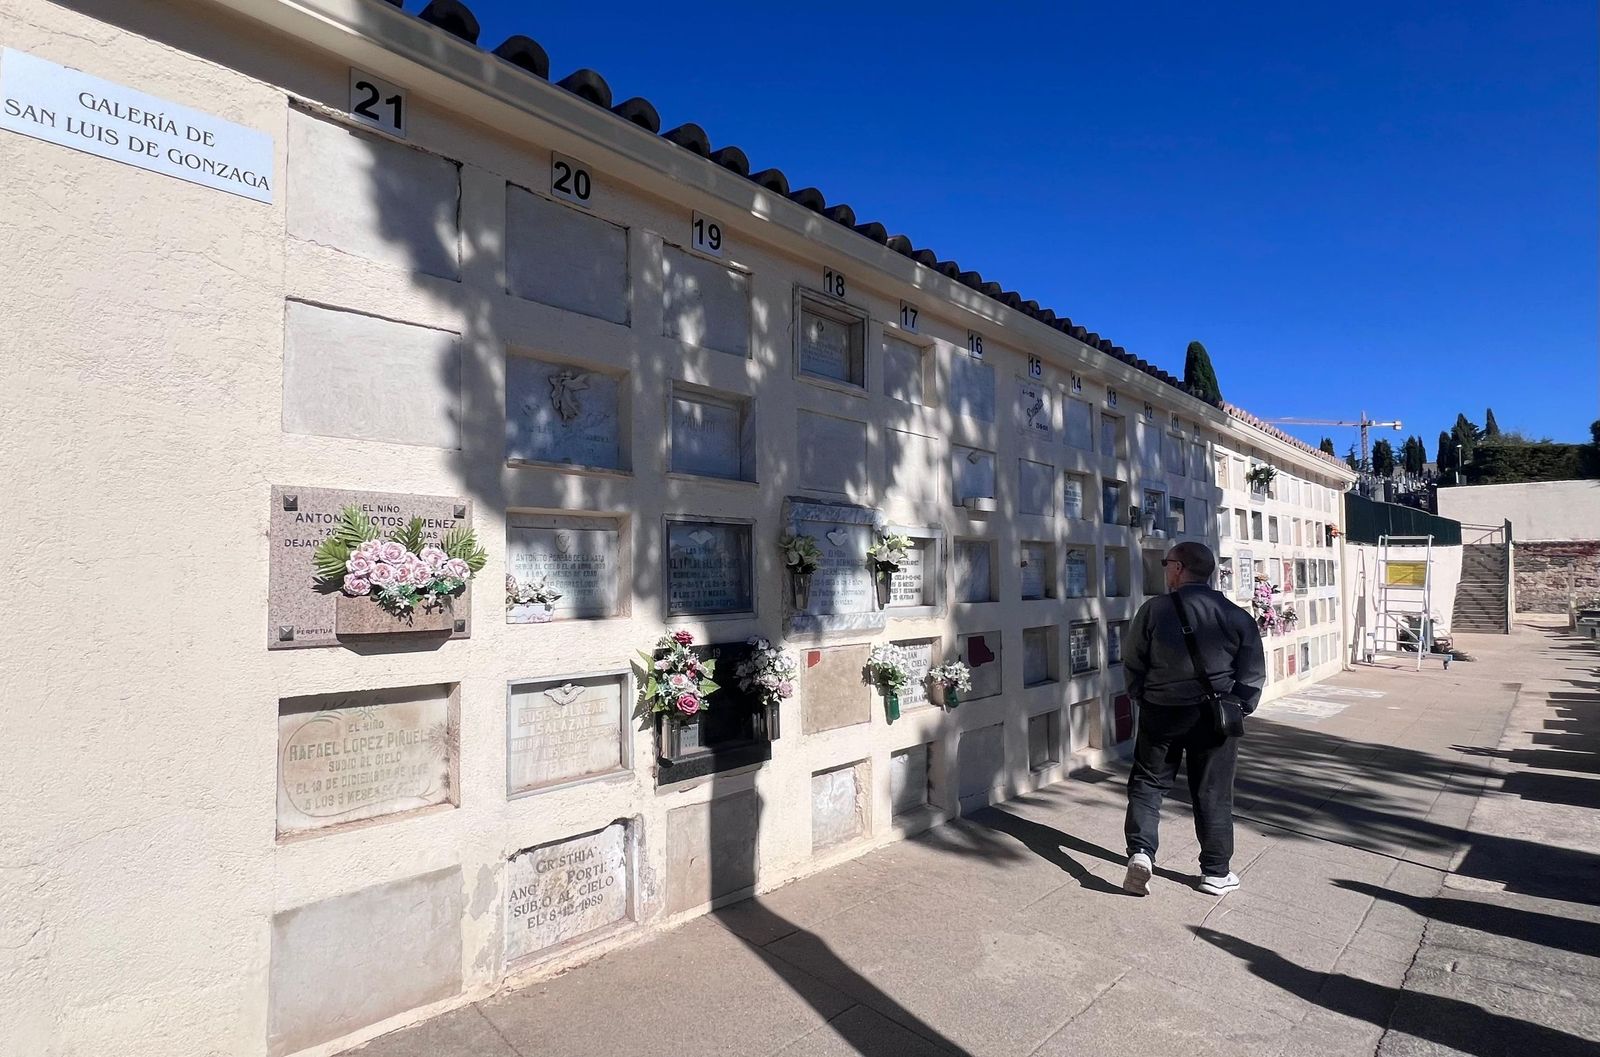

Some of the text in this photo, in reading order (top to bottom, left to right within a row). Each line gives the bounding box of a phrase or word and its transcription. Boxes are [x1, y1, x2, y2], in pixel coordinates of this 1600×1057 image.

[355, 81, 402, 130] 21
[78, 91, 216, 148] GALERÍA DE
[4, 98, 270, 191] SAN LUIS DE GONZAGA
[553, 161, 591, 200] 20
[694, 219, 721, 250] 19
[825, 271, 845, 297] 18
[901, 305, 918, 329] 17
[969, 334, 983, 355] 16
[1029, 357, 1042, 376] 15
[1071, 374, 1081, 392] 14
[1108, 390, 1117, 406] 13
[295, 513, 347, 524] ANTON
[362, 504, 373, 512] EL
[911, 658, 928, 668] CIELO
[289, 741, 341, 762] RAFAEL
[343, 734, 385, 754] LOPEZ
[375, 751, 402, 766] CIELO
[296, 782, 309, 796] EL
[579, 875, 614, 896] CIELO
[527, 915, 544, 930] EL
